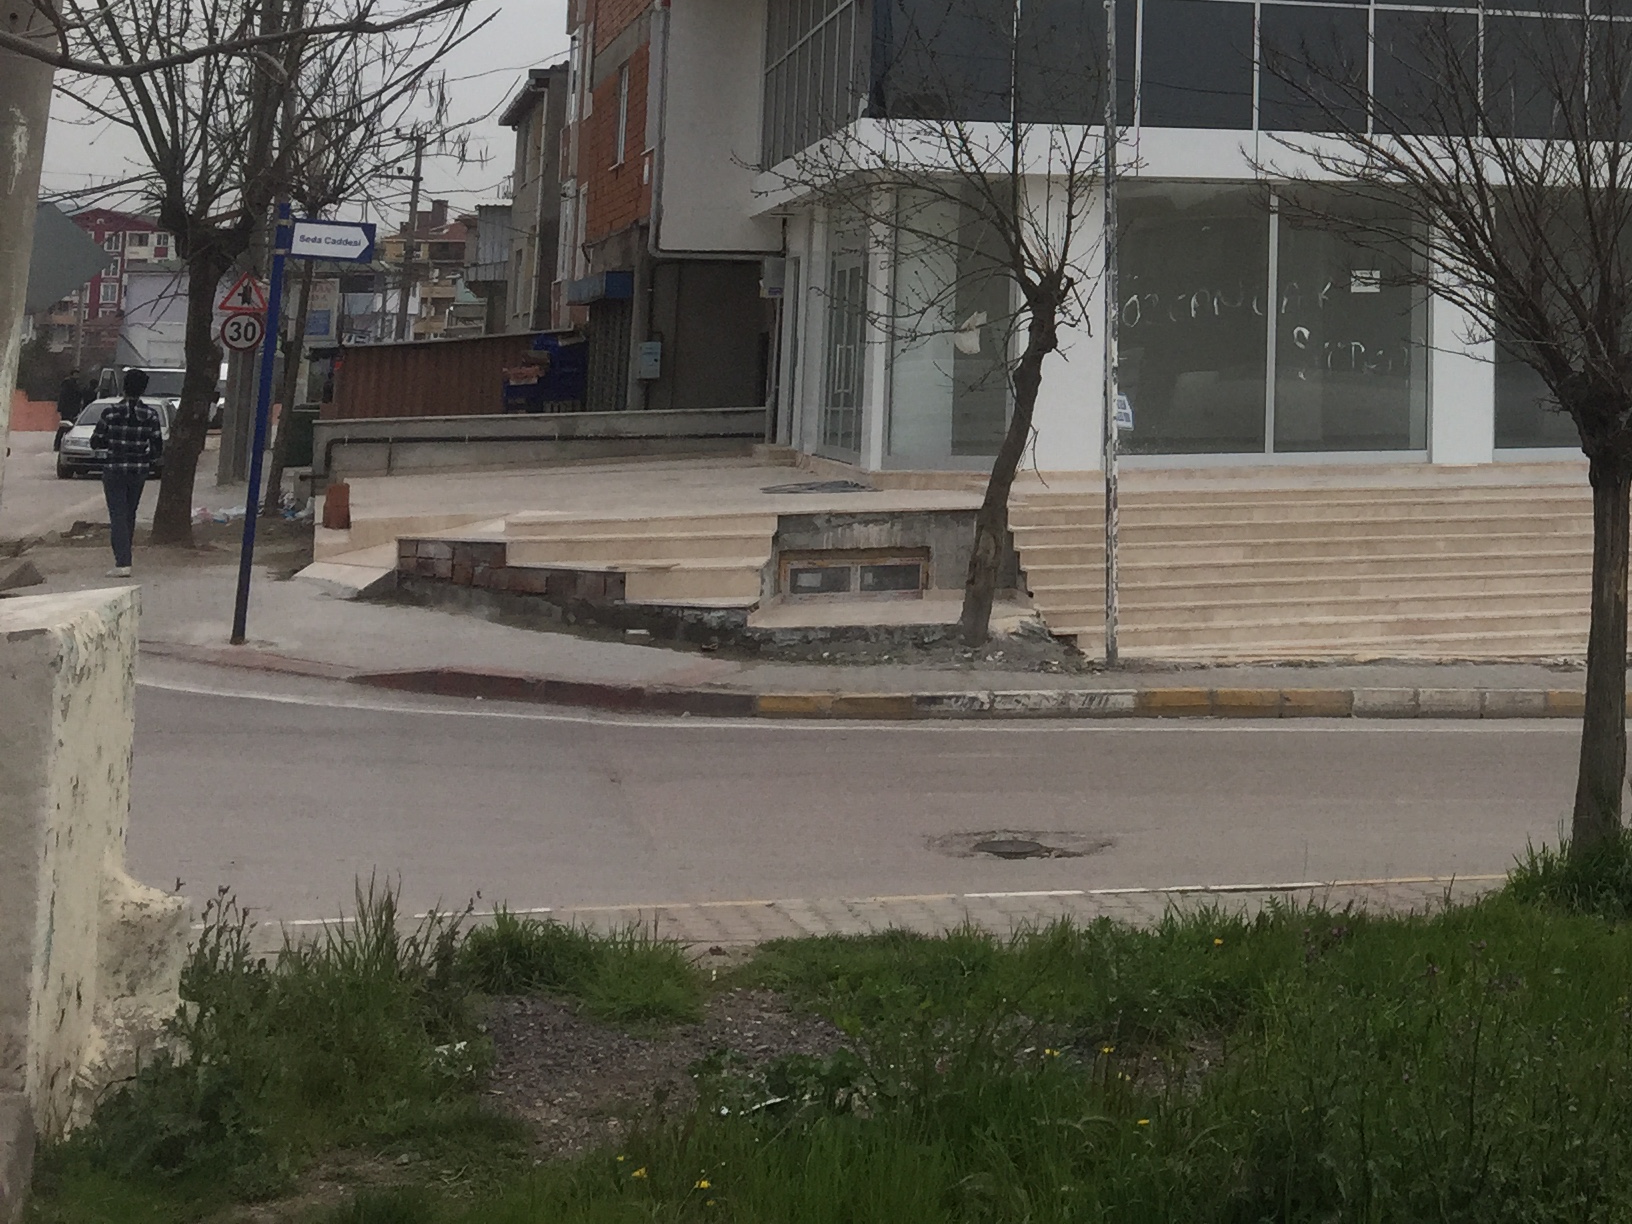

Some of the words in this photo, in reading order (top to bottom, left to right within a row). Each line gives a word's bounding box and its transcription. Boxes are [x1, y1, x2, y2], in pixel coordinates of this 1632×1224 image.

[299, 234, 322, 244] Seda
[324, 236, 362, 247] Caddesi
[228, 321, 256, 342] 30
